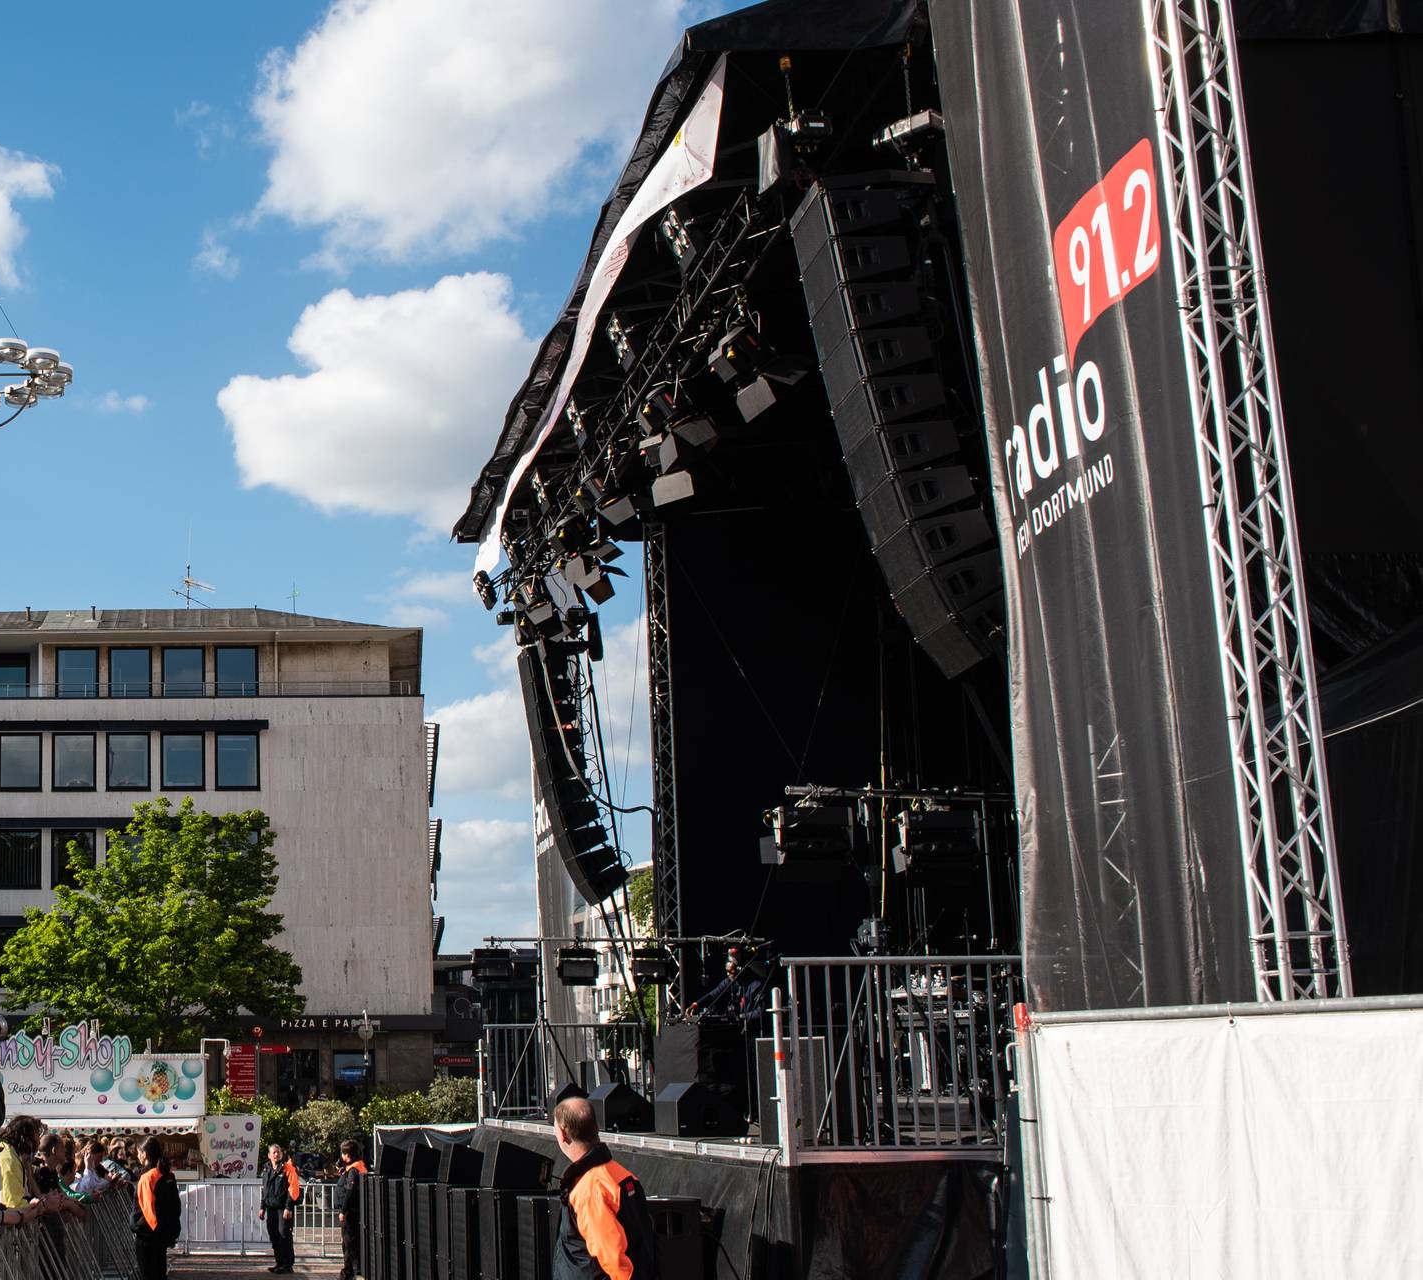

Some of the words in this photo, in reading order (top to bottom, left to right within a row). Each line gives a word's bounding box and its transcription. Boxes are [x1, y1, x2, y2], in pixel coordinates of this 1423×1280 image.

[1069, 169, 1158, 324] 91.2
[1005, 353, 1105, 516] radio
[1032, 454, 1114, 535] DORTMUND
[322, 1019, 328, 1028] E
[7, 1083, 48, 1095] Rüdiger
[50, 1082, 87, 1095] Hornig
[21, 1094, 75, 1105] Dortmund
